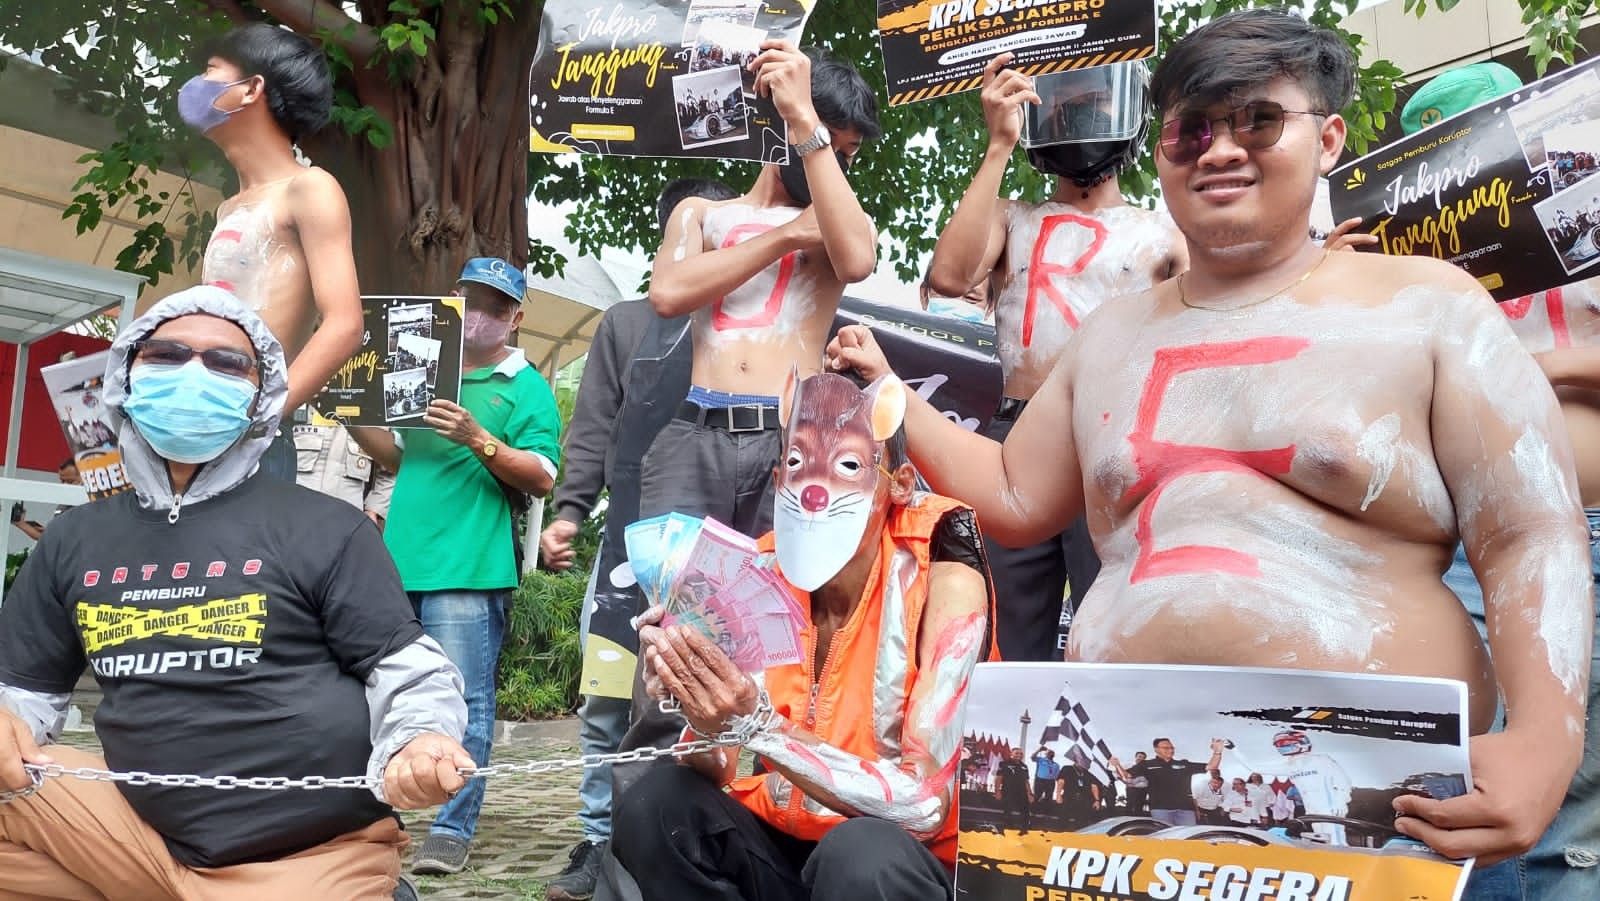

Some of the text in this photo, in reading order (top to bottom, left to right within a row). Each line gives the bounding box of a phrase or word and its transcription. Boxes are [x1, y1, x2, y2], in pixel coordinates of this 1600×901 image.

[578, 2, 658, 51] Jakpro
[920, 15, 1006, 45] PERIKSA
[1012, 0, 1105, 22] JAKPRO
[924, 36, 976, 52] BONGKAR
[979, 23, 1028, 40] KORUPSI
[1031, 14, 1089, 28] FORMULA
[928, 0, 976, 31] KPK
[1081, 38, 1115, 47] JANGAN
[551, 41, 667, 99] Tanggung
[585, 105, 609, 114] Formula
[1377, 127, 1473, 171] Satgas Pemburu Koruptor
[1384, 154, 1482, 216] Jakpro
[1369, 177, 1513, 260] Tanggung
[1023, 214, 1109, 348] R
[858, 314, 966, 343] Satgas
[1119, 335, 1312, 585] E
[84, 559, 263, 587] SATGAS
[121, 585, 207, 603] PEMBURU
[97, 624, 133, 643] DANGER
[143, 613, 189, 632] DANGER
[201, 602, 250, 620] DANGER
[90, 646, 264, 678] KORUPTOR
[1043, 846, 1350, 901] KPK SEGERA
